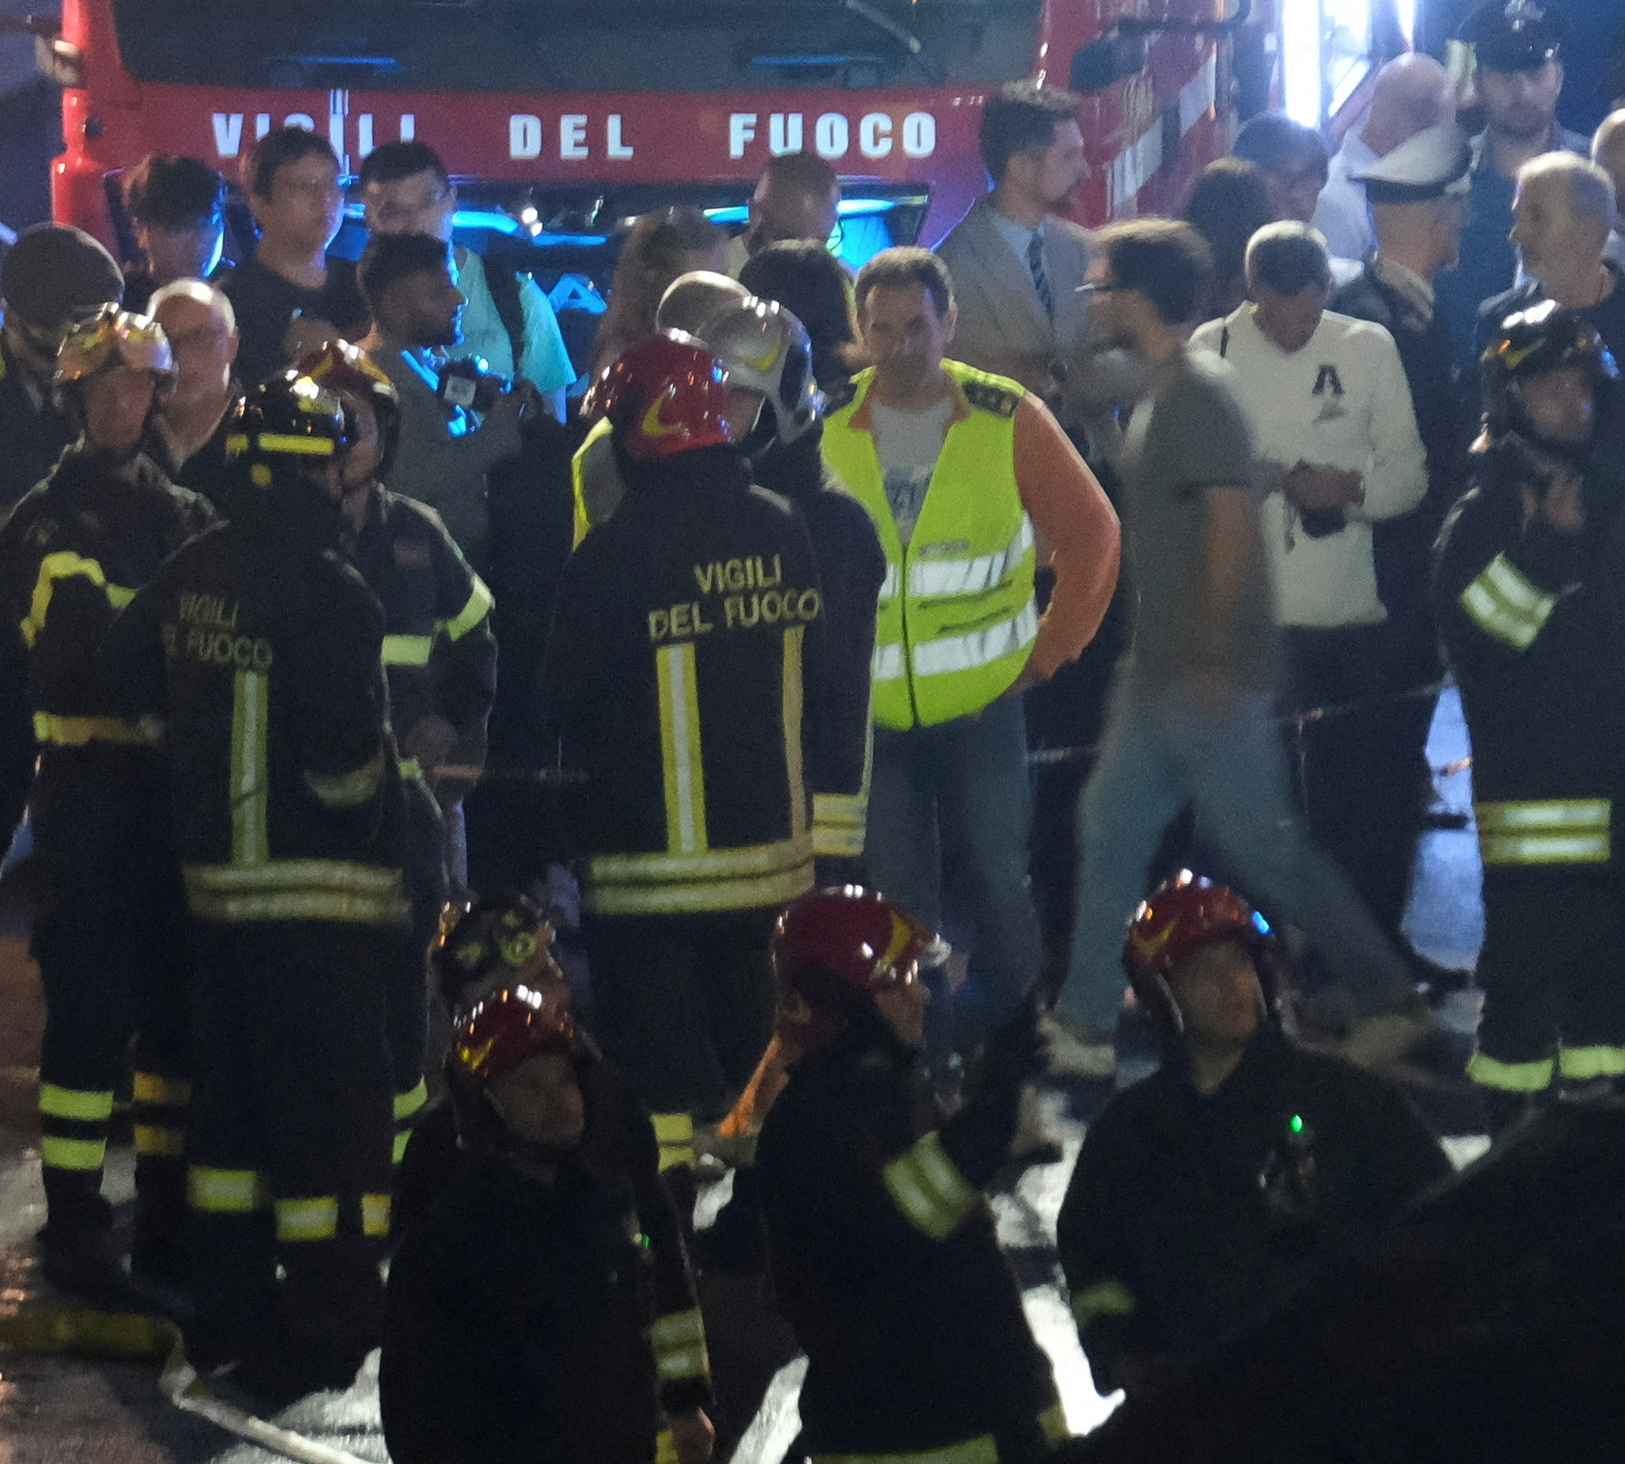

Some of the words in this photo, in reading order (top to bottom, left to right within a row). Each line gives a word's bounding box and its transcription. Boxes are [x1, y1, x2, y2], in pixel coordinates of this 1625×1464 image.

[508, 113, 635, 160] DEL
[729, 111, 938, 159] FUOCO
[693, 553, 782, 594] VIGILI
[647, 601, 714, 642] DEL
[723, 587, 821, 629] FUOCO
